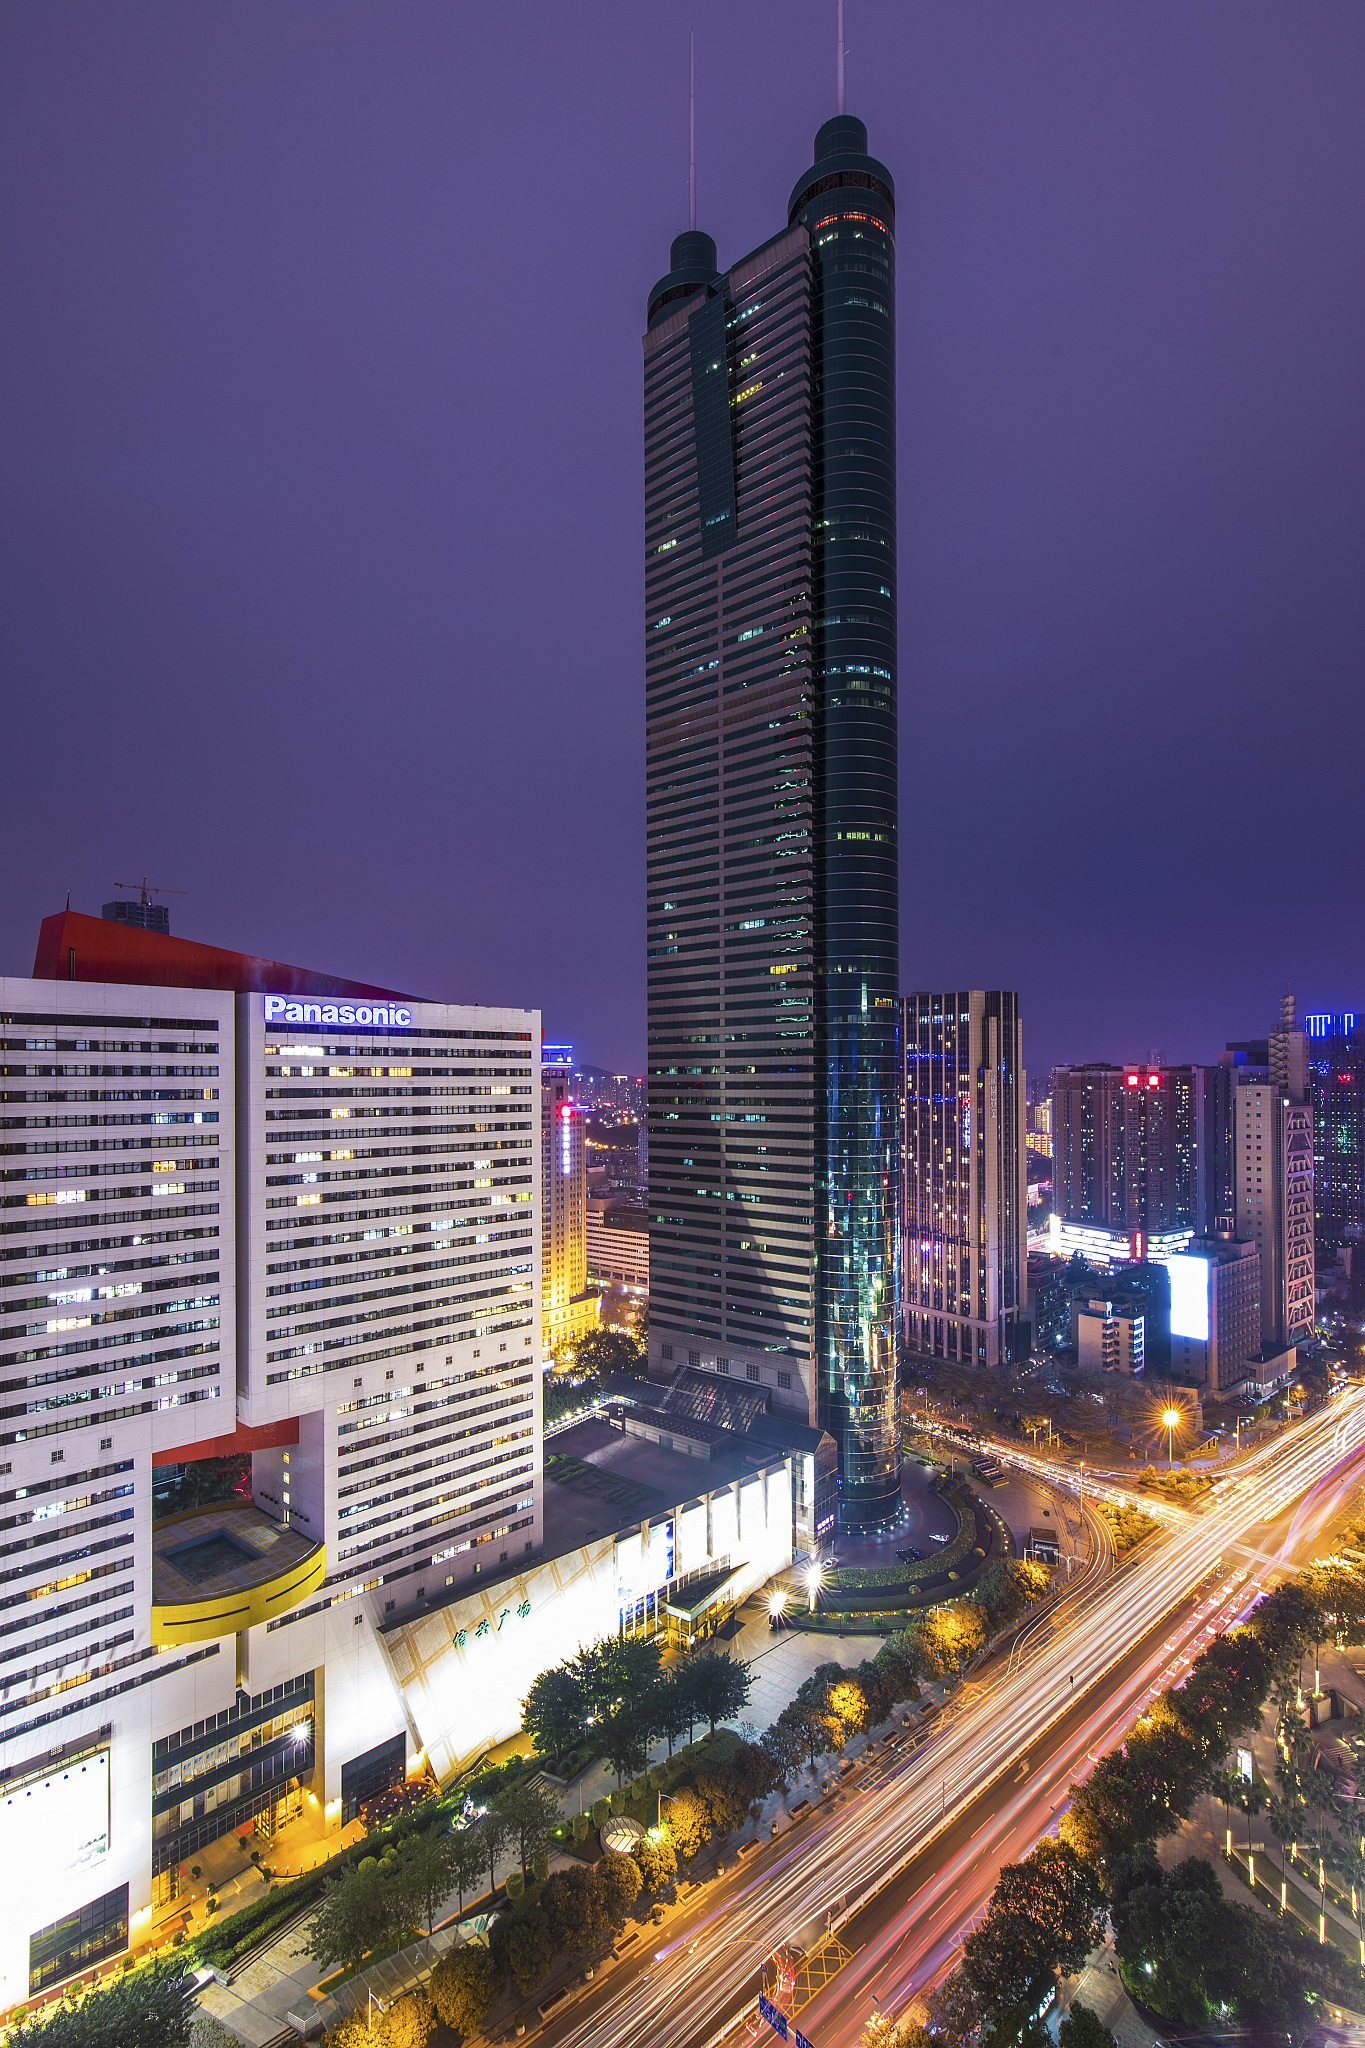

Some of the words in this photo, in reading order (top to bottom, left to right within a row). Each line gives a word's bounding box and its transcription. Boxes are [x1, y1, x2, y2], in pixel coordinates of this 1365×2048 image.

[264, 995, 411, 1026] Panasonic
[453, 1600, 531, 1649] 信兴广场
[230, 1739, 237, 1747] EF
[218, 1745, 226, 1753] EF
[207, 1751, 214, 1759] EF
[195, 1756, 202, 1764] EF
[183, 1762, 191, 1770] EF
[170, 1768, 178, 1776] EF
[158, 1774, 166, 1782] EF
